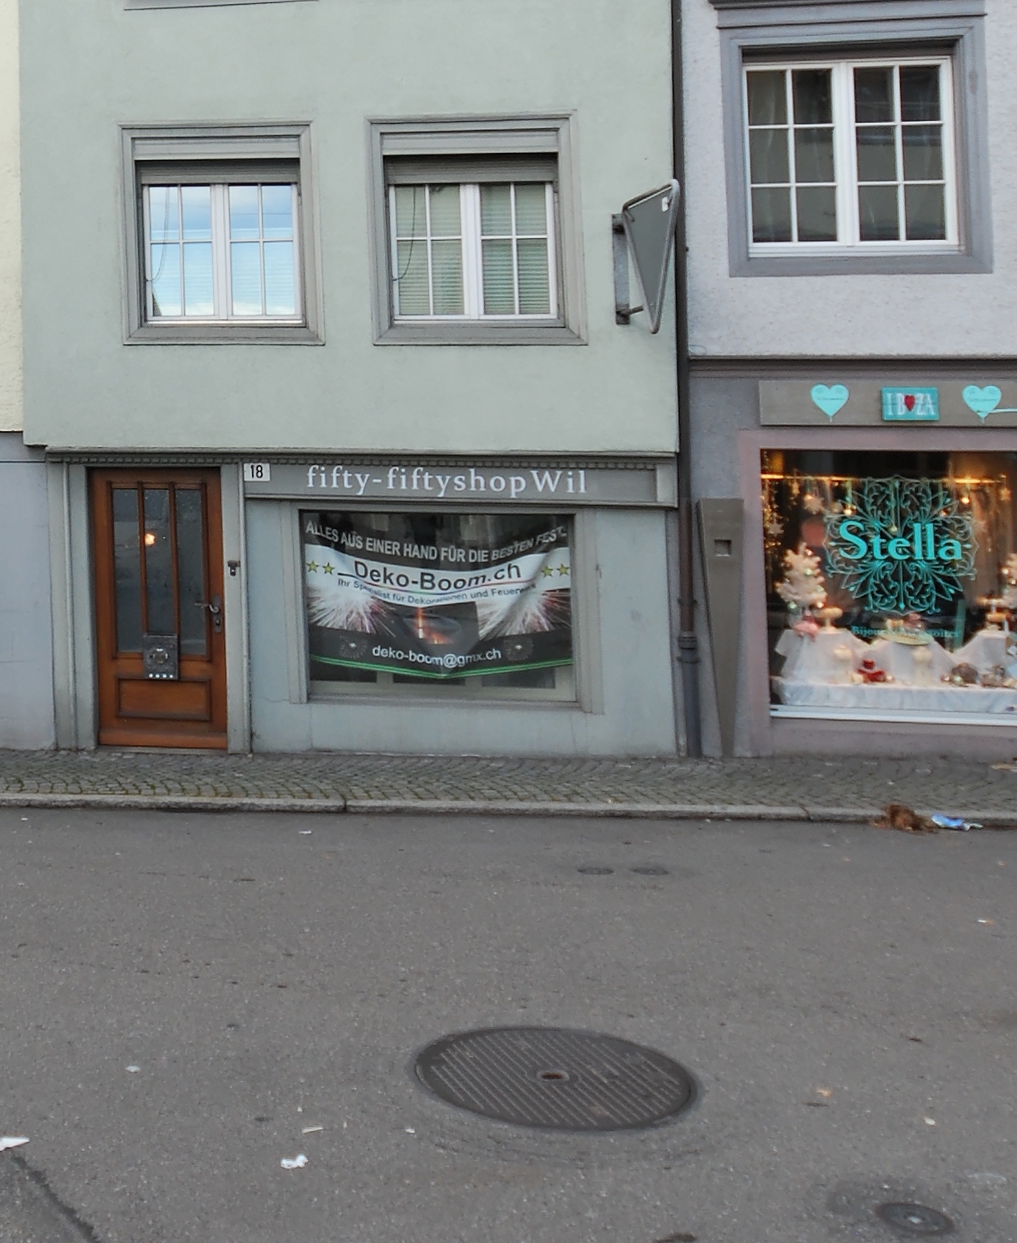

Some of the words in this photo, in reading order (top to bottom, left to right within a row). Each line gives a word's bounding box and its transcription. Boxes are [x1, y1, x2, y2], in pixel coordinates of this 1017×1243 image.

[250, 464, 264, 479] 18
[306, 520, 339, 543] ALLES
[341, 532, 363, 549] AUS
[366, 537, 401, 556] EINER
[403, 543, 437, 560] HAND
[441, 545, 466, 562] FÜR
[469, 550, 489, 562] DIE
[491, 538, 534, 561] BESTEN
[839, 520, 961, 560] Stella
[354, 560, 521, 591] Deko-Boom.ch
[338, 578, 350, 587] Ihr
[392, 593, 405, 602] für
[470, 589, 488, 599] und
[372, 645, 501, 668] deko-boom@gmx.ch
